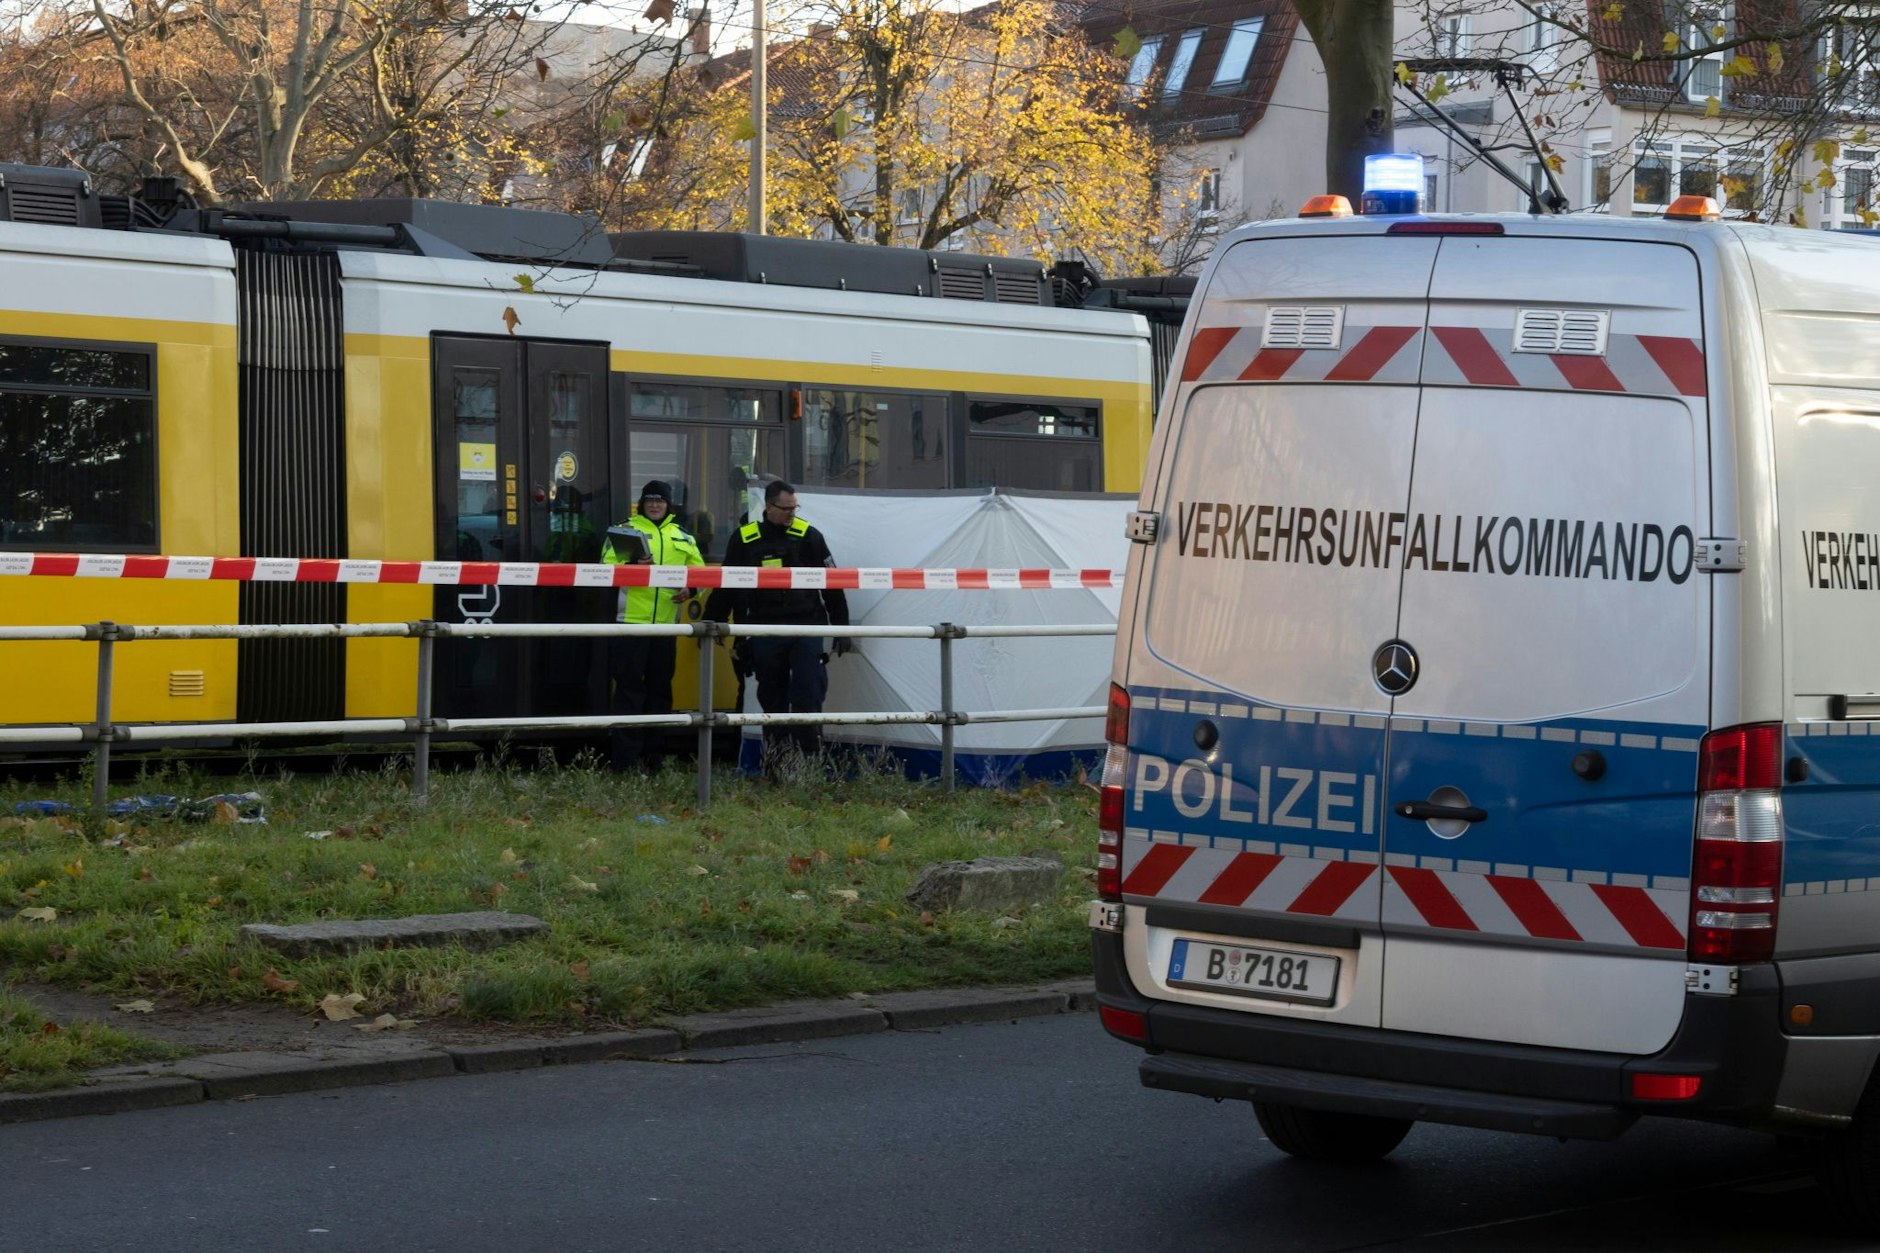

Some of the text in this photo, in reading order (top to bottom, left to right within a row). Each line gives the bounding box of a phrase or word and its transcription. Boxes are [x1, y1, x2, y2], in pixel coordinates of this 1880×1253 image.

[1177, 501, 1694, 585] VERKEHRSUNFALLKOMMANDO
[1133, 753, 1376, 835] POLIZEI
[1206, 948, 1310, 992] B 7181
